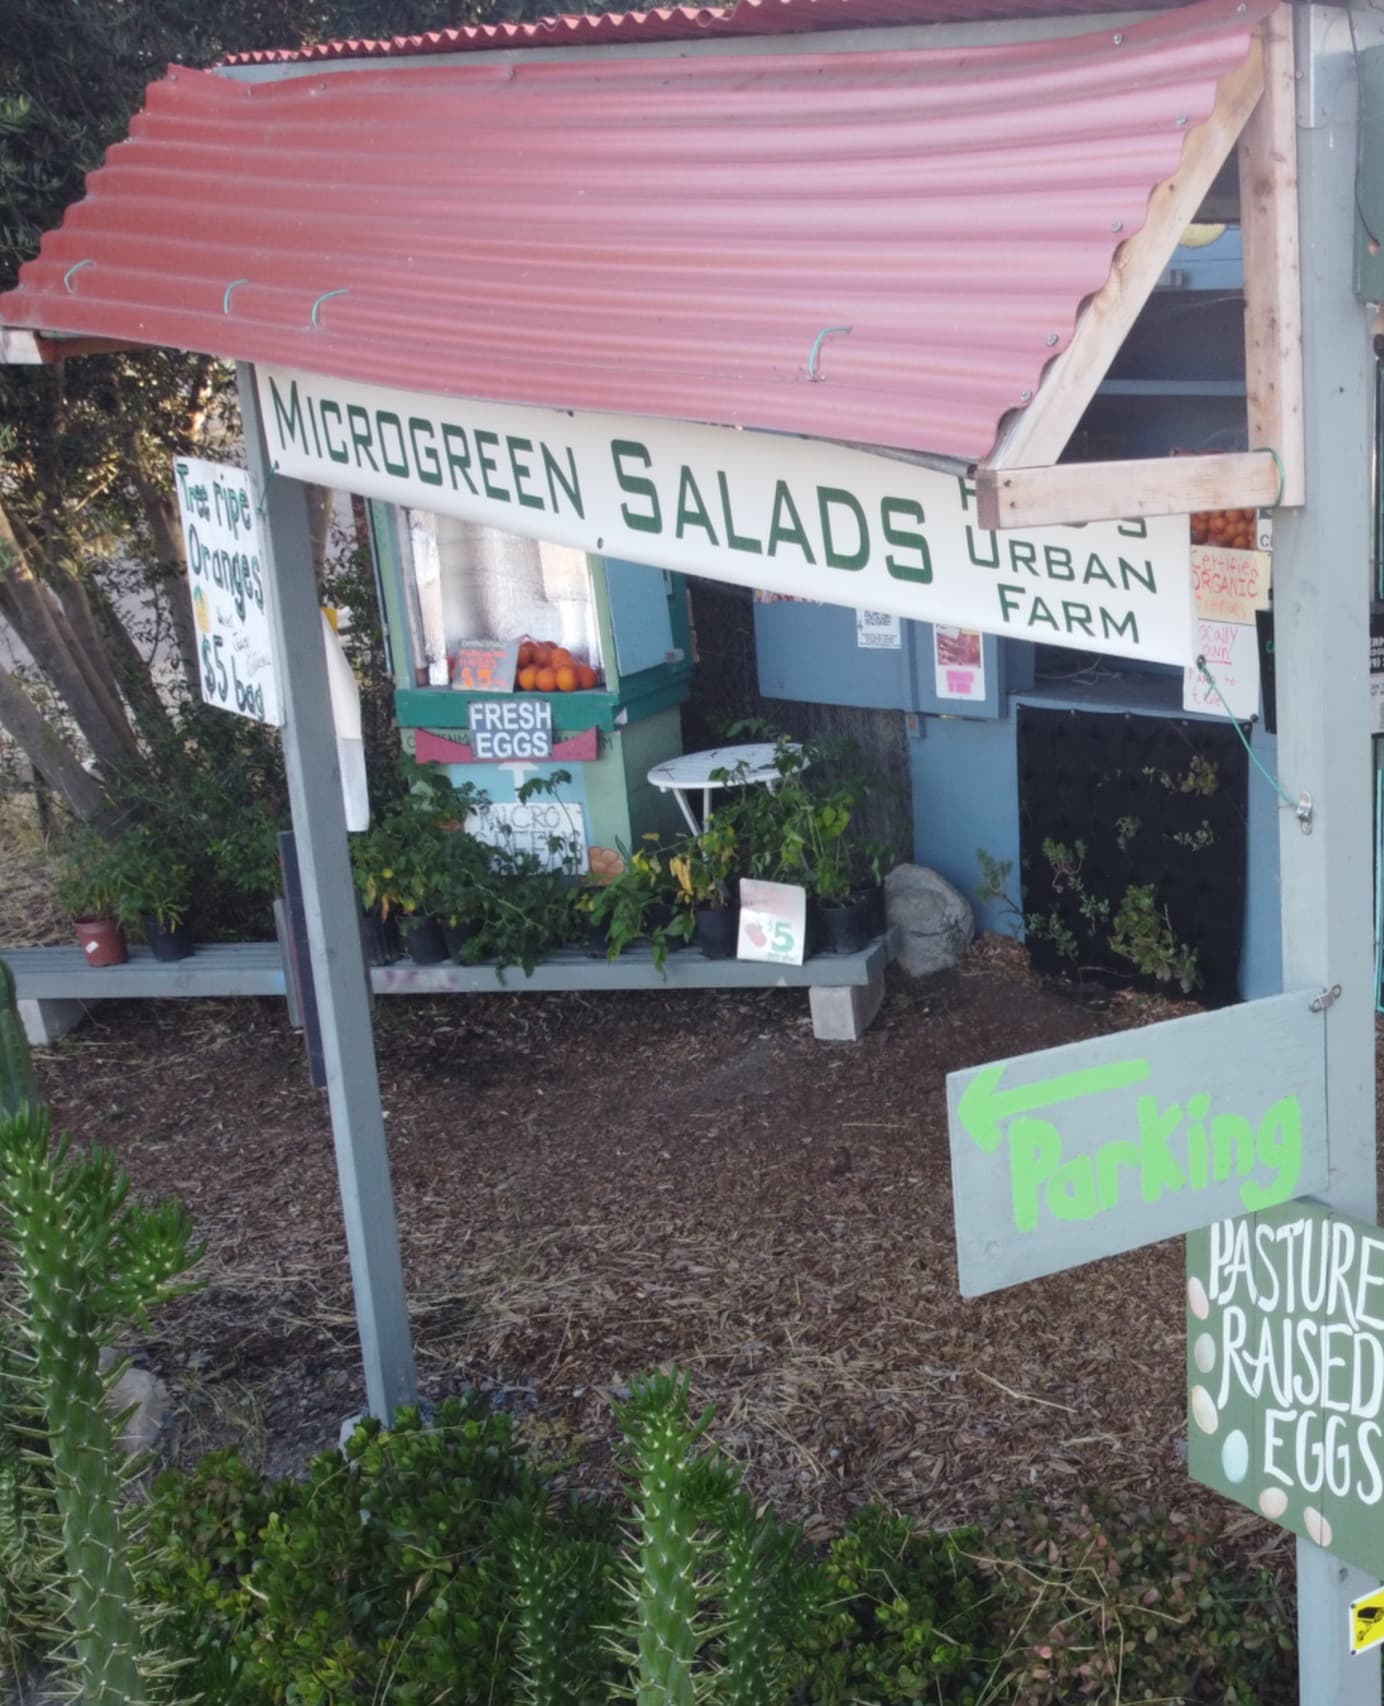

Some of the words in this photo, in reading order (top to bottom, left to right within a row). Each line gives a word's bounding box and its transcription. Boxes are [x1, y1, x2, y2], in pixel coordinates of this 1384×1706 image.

[177, 463, 211, 522] Tree
[212, 474, 252, 540] ripe
[268, 376, 586, 521] MICROGREEN
[610, 438, 933, 585] SALADS
[189, 523, 264, 622] Oranges
[965, 525, 1158, 594] URBAN
[1193, 551, 1259, 577] ertified
[997, 583, 1140, 644] FARM
[1200, 624, 1238, 641] ocally
[202, 633, 229, 703] $5
[231, 654, 265, 722] bag
[469, 701, 552, 730] FRESH
[476, 732, 549, 759] EGGS
[1006, 1092, 1300, 1234] Parking
[1262, 1408, 1384, 1506] EGGS
